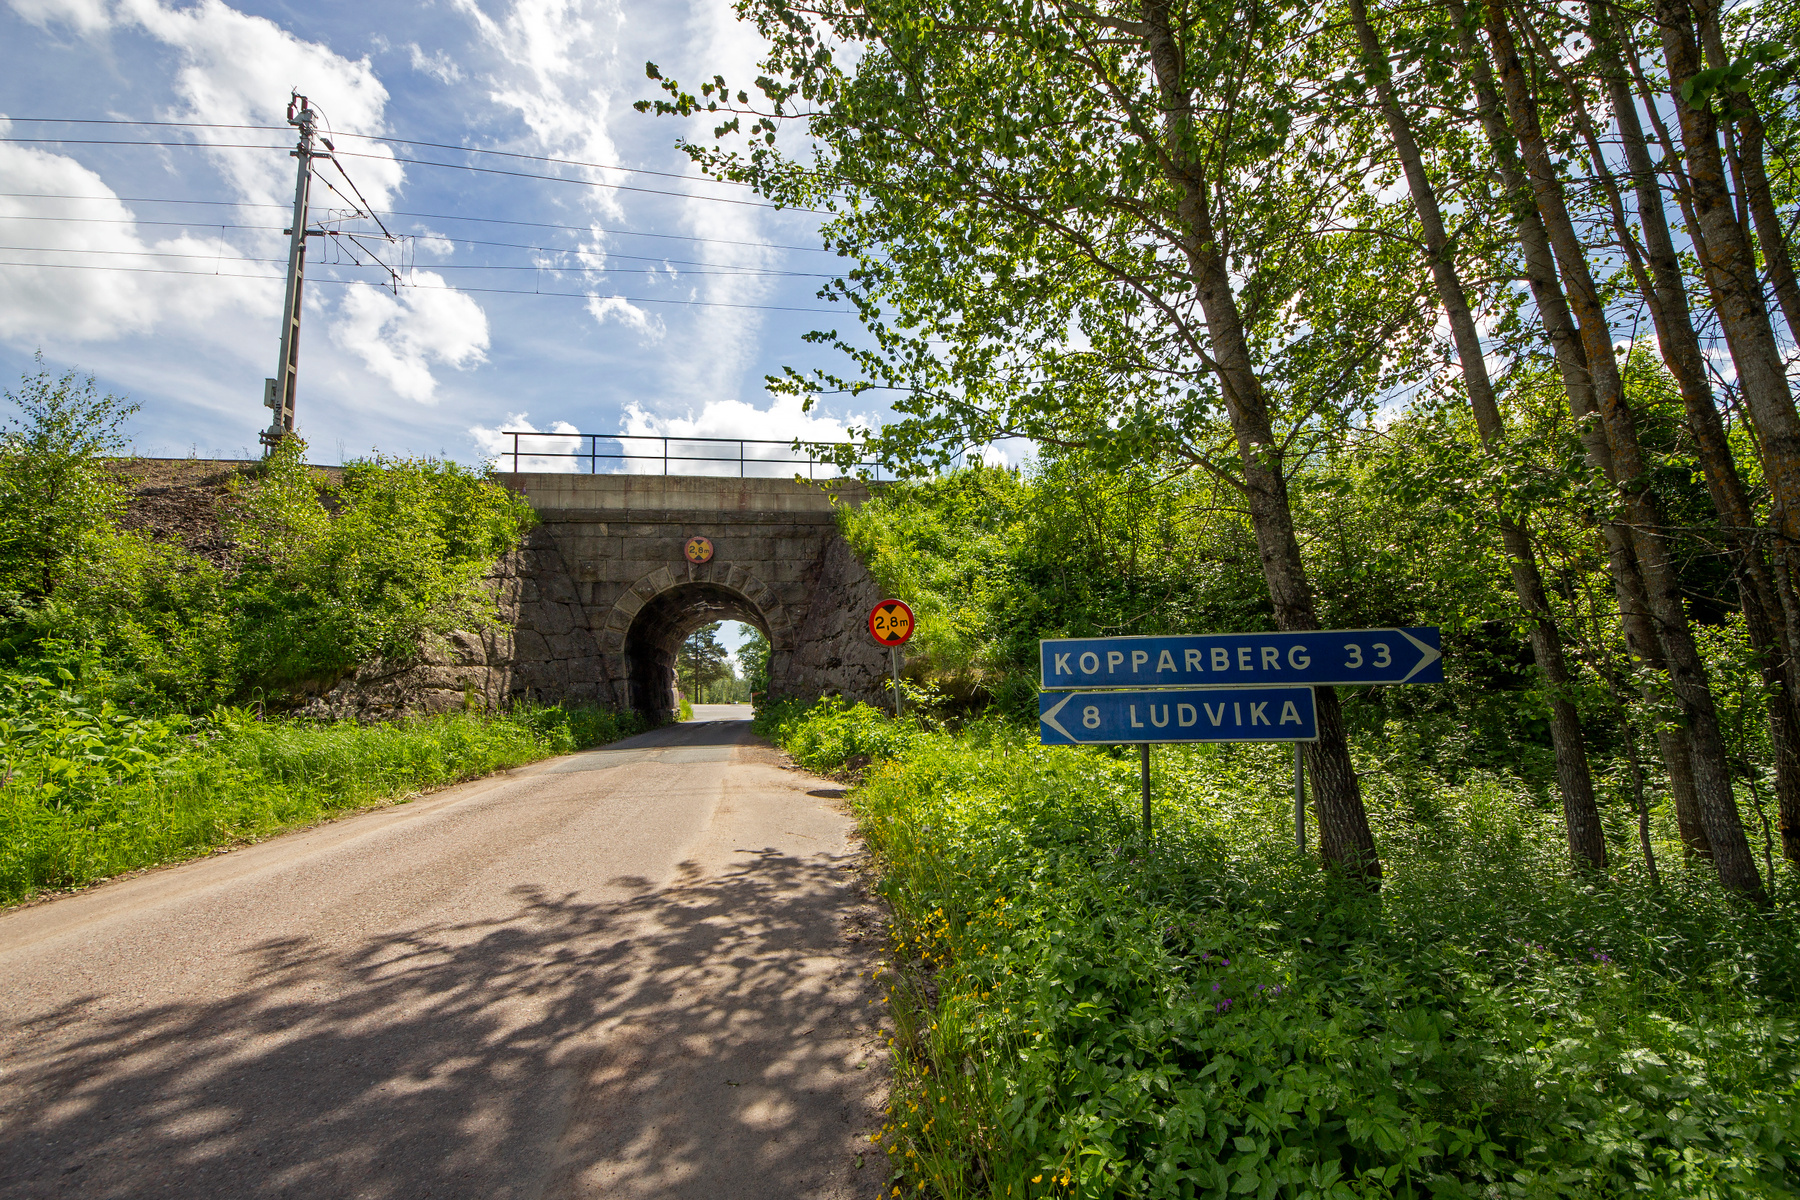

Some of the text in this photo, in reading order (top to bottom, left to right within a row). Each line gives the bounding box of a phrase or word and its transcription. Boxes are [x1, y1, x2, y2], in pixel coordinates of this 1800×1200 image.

[1054, 643, 1392, 676] KOPPARBERG 33
[1082, 700, 1303, 729] 8 LUDVIKA
